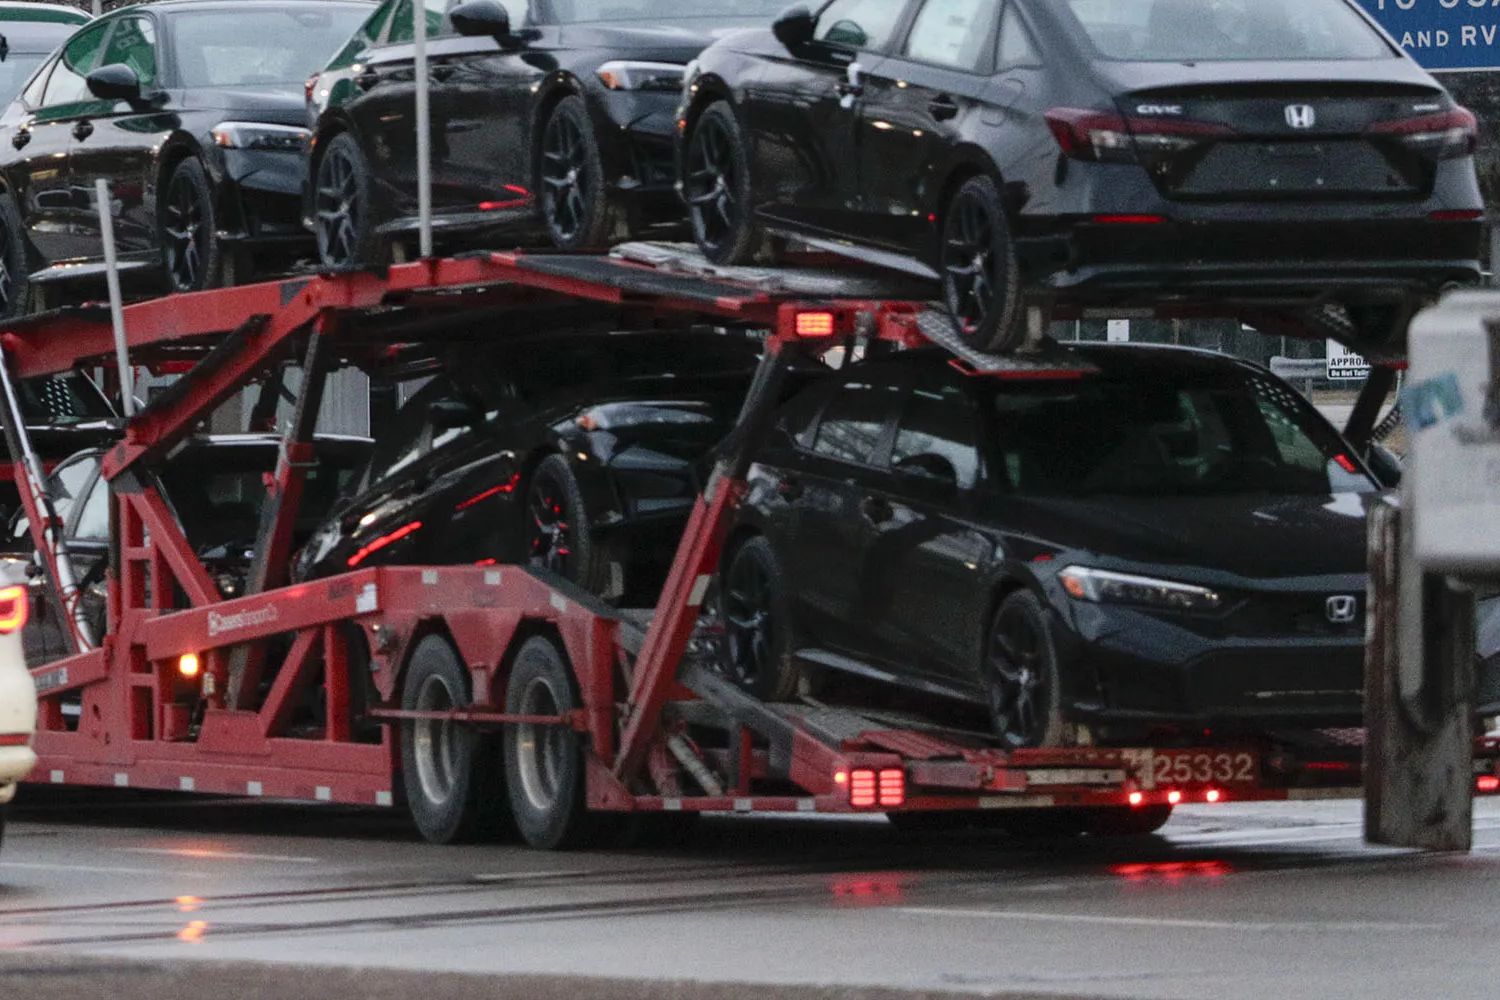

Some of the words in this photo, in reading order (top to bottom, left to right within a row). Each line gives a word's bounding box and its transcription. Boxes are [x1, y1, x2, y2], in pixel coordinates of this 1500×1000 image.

[1401, 30, 1449, 48] AND
[1461, 24, 1497, 46] RV
[1136, 104, 1182, 115] CIVIC
[1154, 753, 1254, 783] 25332
